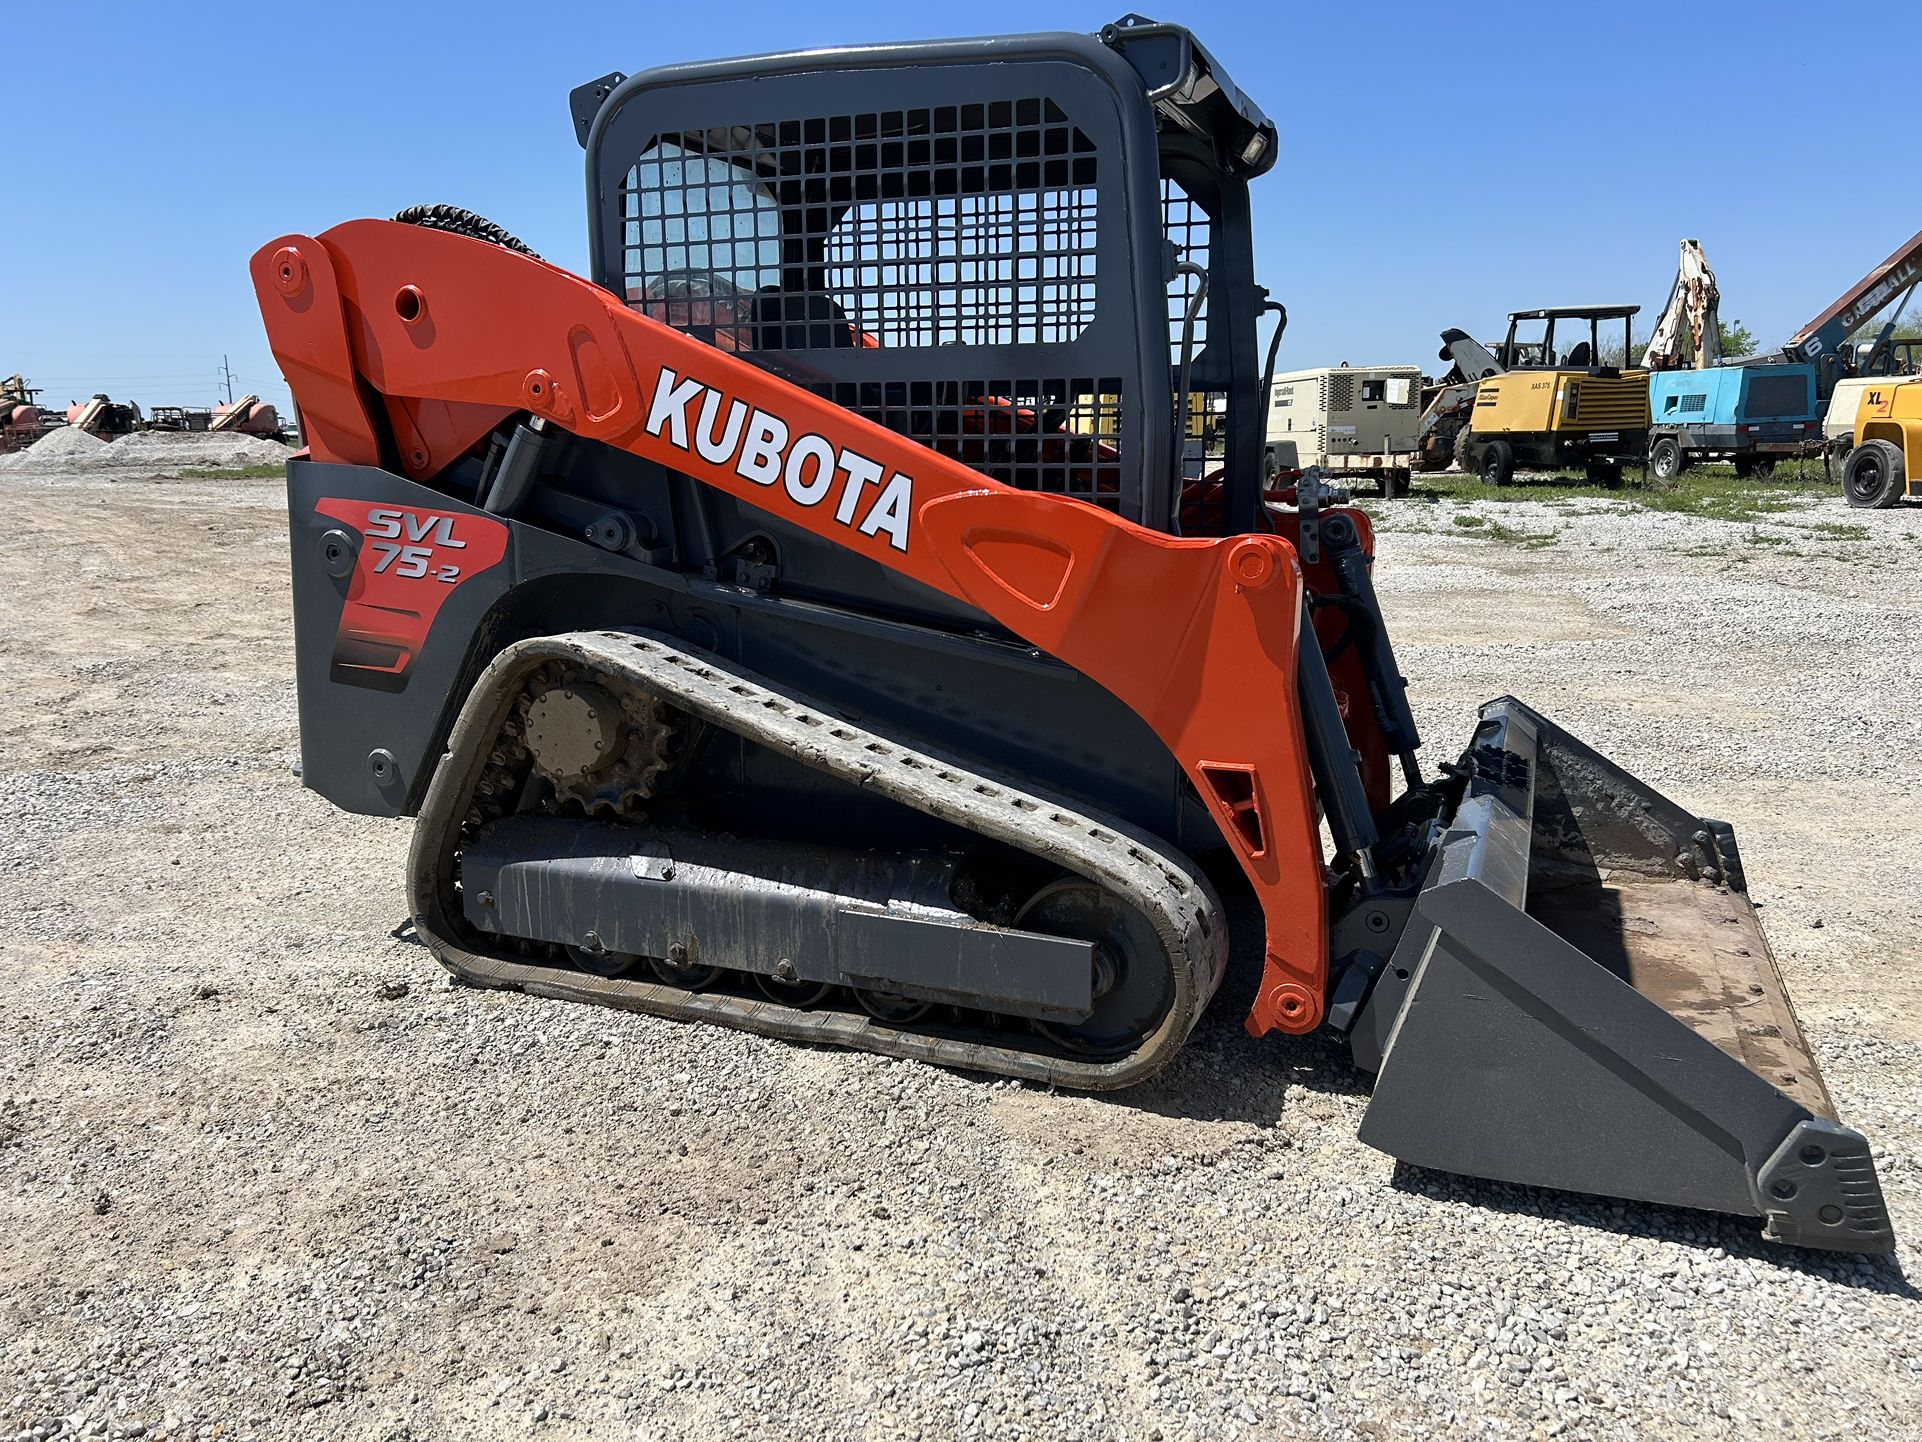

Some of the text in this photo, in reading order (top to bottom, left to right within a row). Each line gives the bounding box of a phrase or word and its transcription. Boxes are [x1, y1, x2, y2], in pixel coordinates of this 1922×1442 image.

[1805, 336, 1823, 357] 6
[645, 365, 913, 554] KUBOTA
[364, 509, 467, 548] SVL
